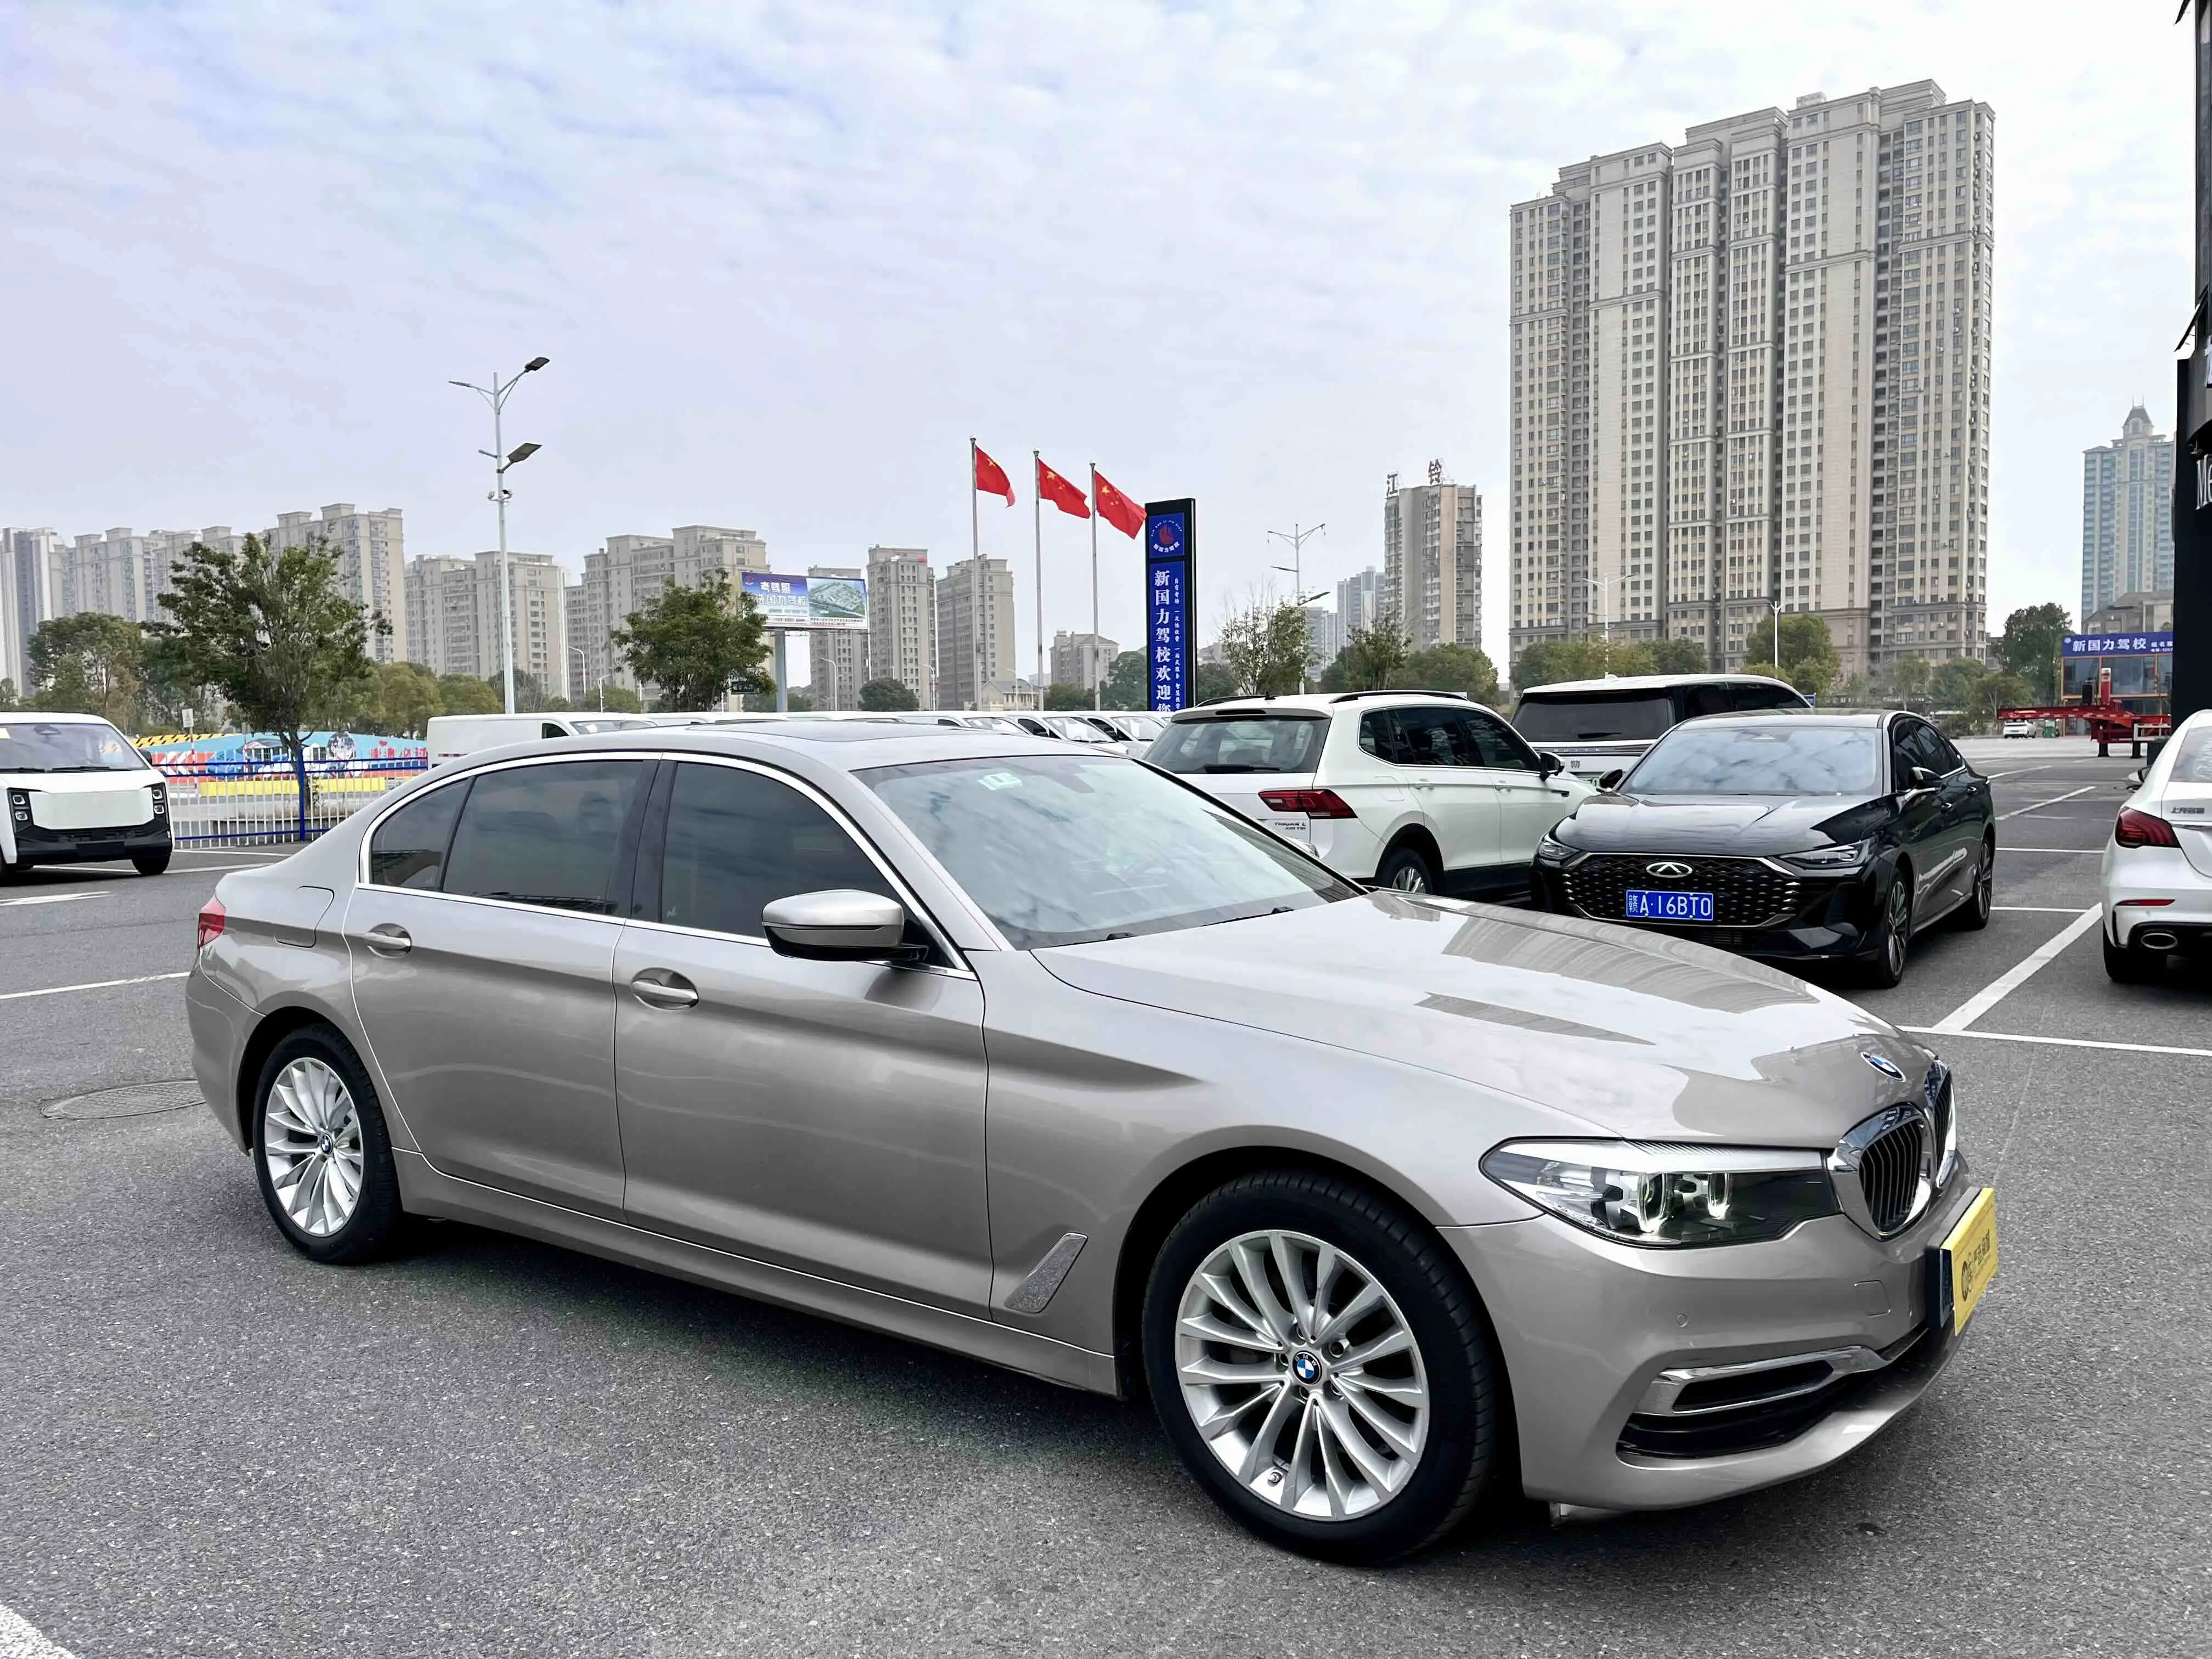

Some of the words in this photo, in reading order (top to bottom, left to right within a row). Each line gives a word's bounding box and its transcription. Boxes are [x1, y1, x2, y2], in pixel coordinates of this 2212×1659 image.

[760, 581, 791, 594] 考驾照
[2072, 637, 2147, 652] 新国力驾校
